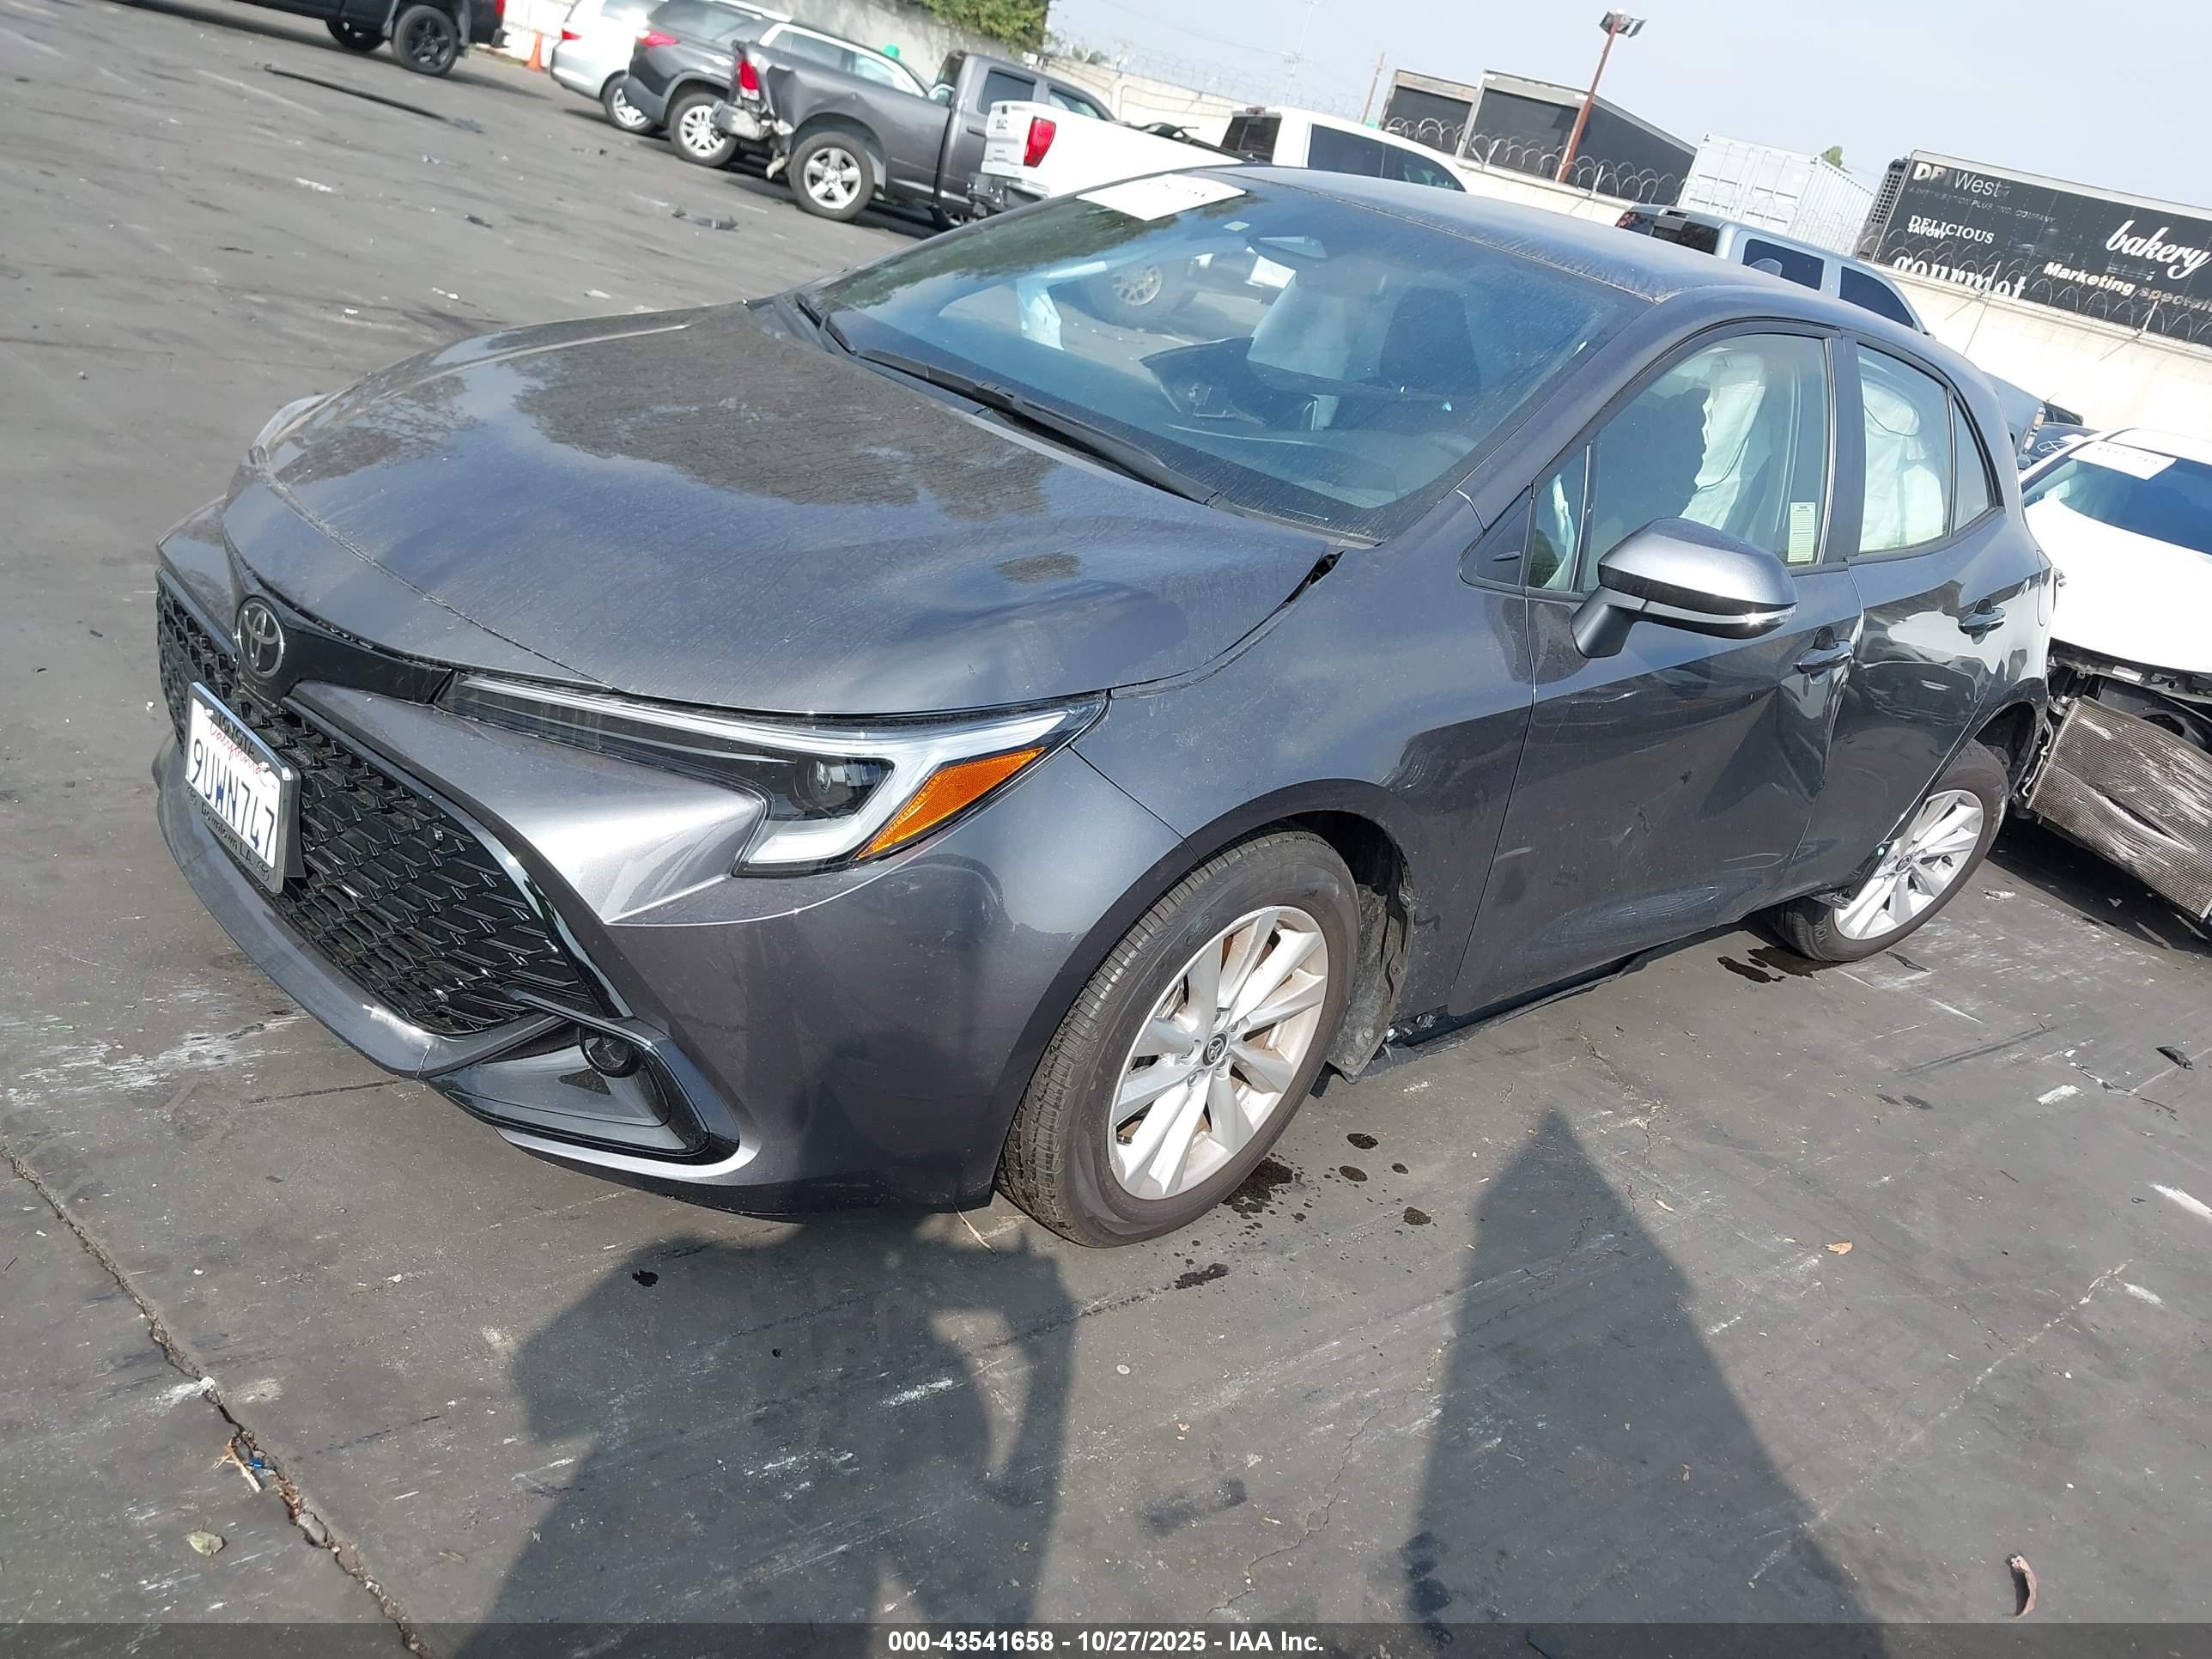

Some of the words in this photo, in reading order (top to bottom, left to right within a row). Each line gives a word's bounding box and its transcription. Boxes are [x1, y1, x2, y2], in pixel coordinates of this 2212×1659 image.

[1954, 171, 2002, 198] West
[1908, 215, 1995, 245] DELICIOUS
[2106, 219, 2212, 280] bakery
[2043, 261, 2136, 296] Marketing
[210, 721, 261, 775] California
[218, 713, 255, 758] TOYOTA
[191, 738, 275, 860] 9UWN747
[200, 801, 240, 849] Downtown
